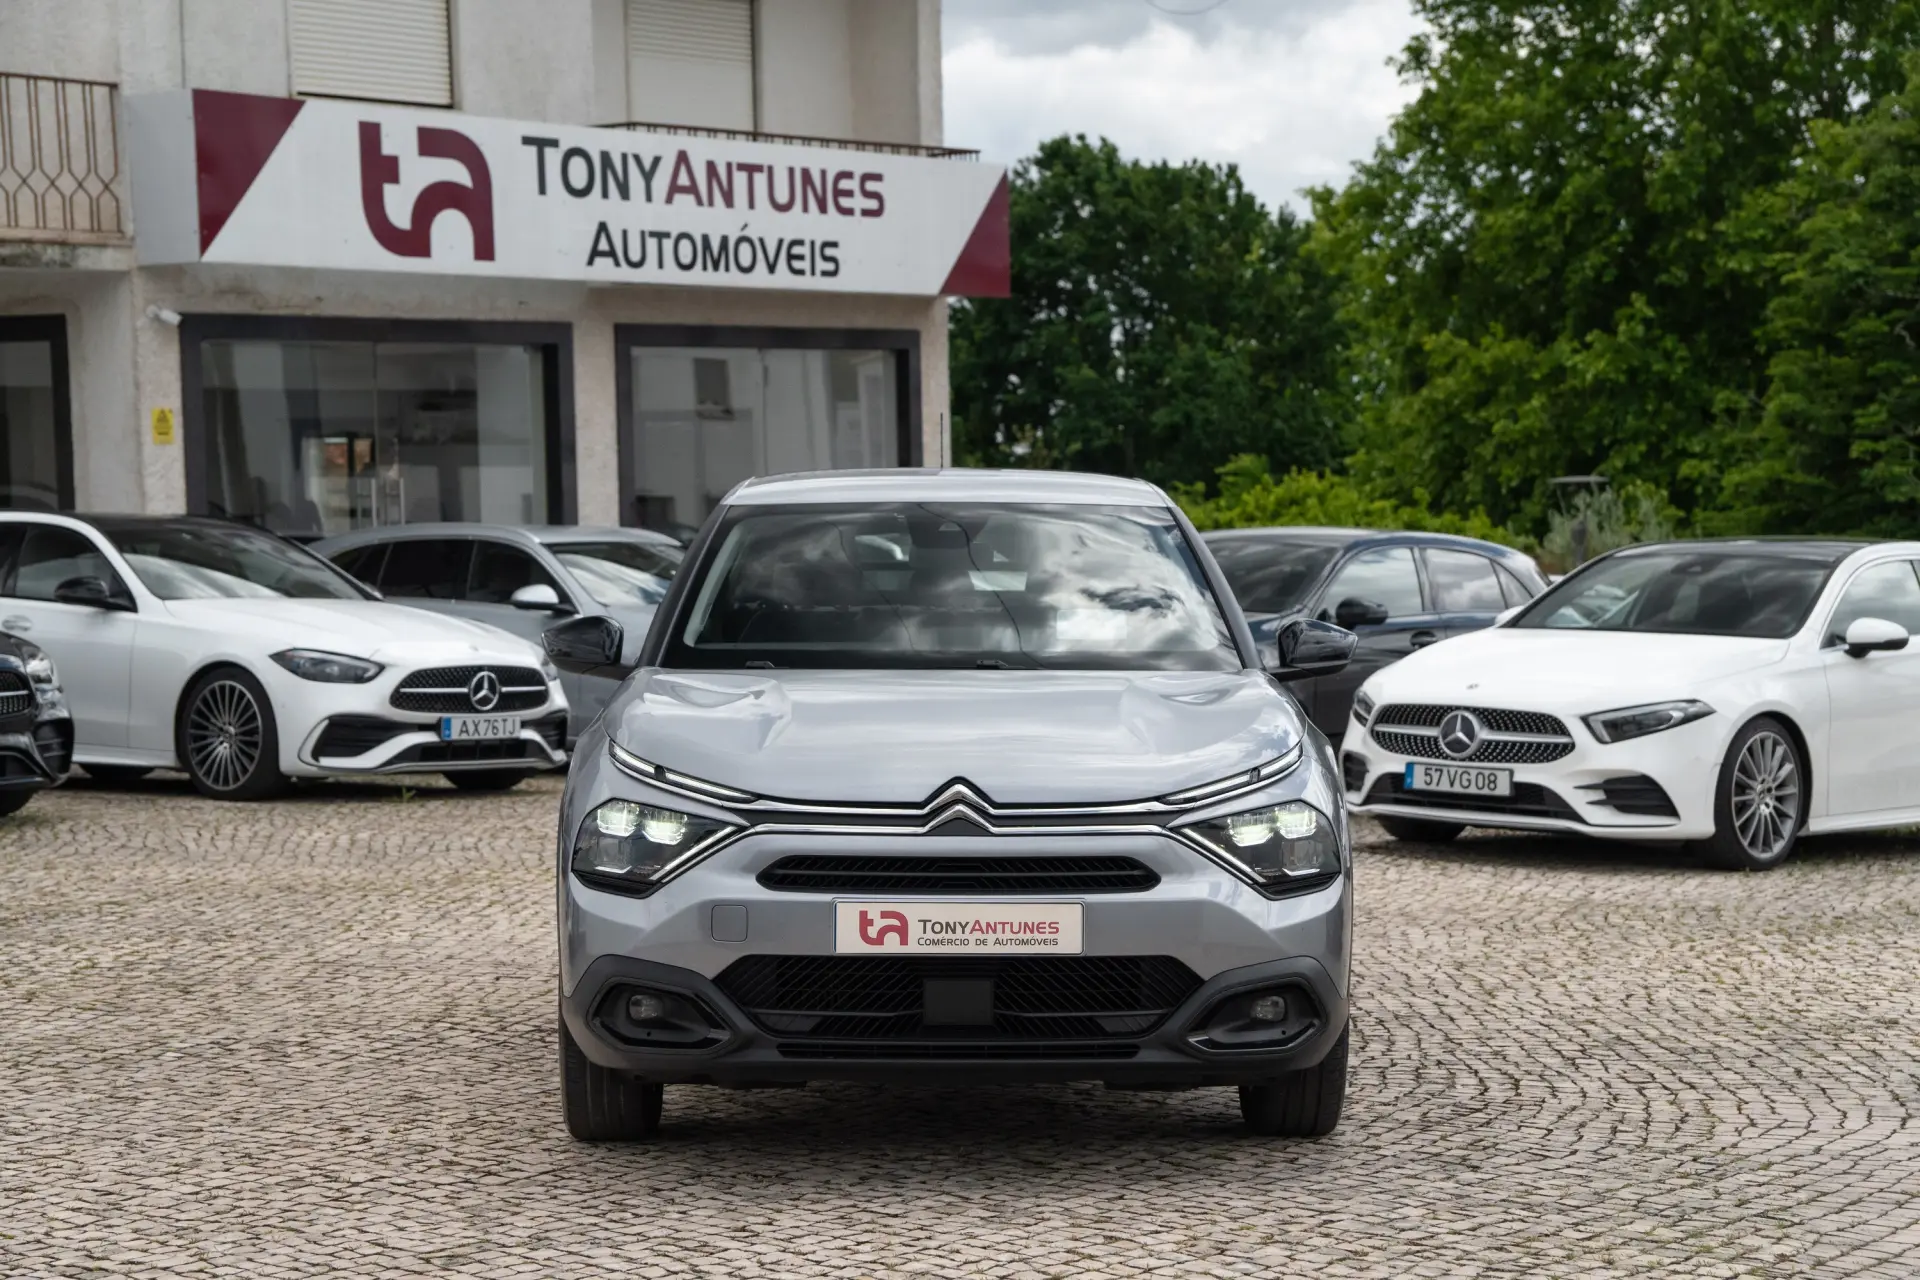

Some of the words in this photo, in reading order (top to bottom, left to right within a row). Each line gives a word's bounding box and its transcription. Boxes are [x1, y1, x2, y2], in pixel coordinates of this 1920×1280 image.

[586, 220, 841, 278] AUTOMÓVEIS
[459, 718, 516, 737] AX76TJ
[1424, 767, 1498, 792] 57VG08
[917, 936, 970, 946] COMÉRCIO
[975, 937, 988, 946] DE
[993, 935, 1059, 946] AUTOMÓVEIS
